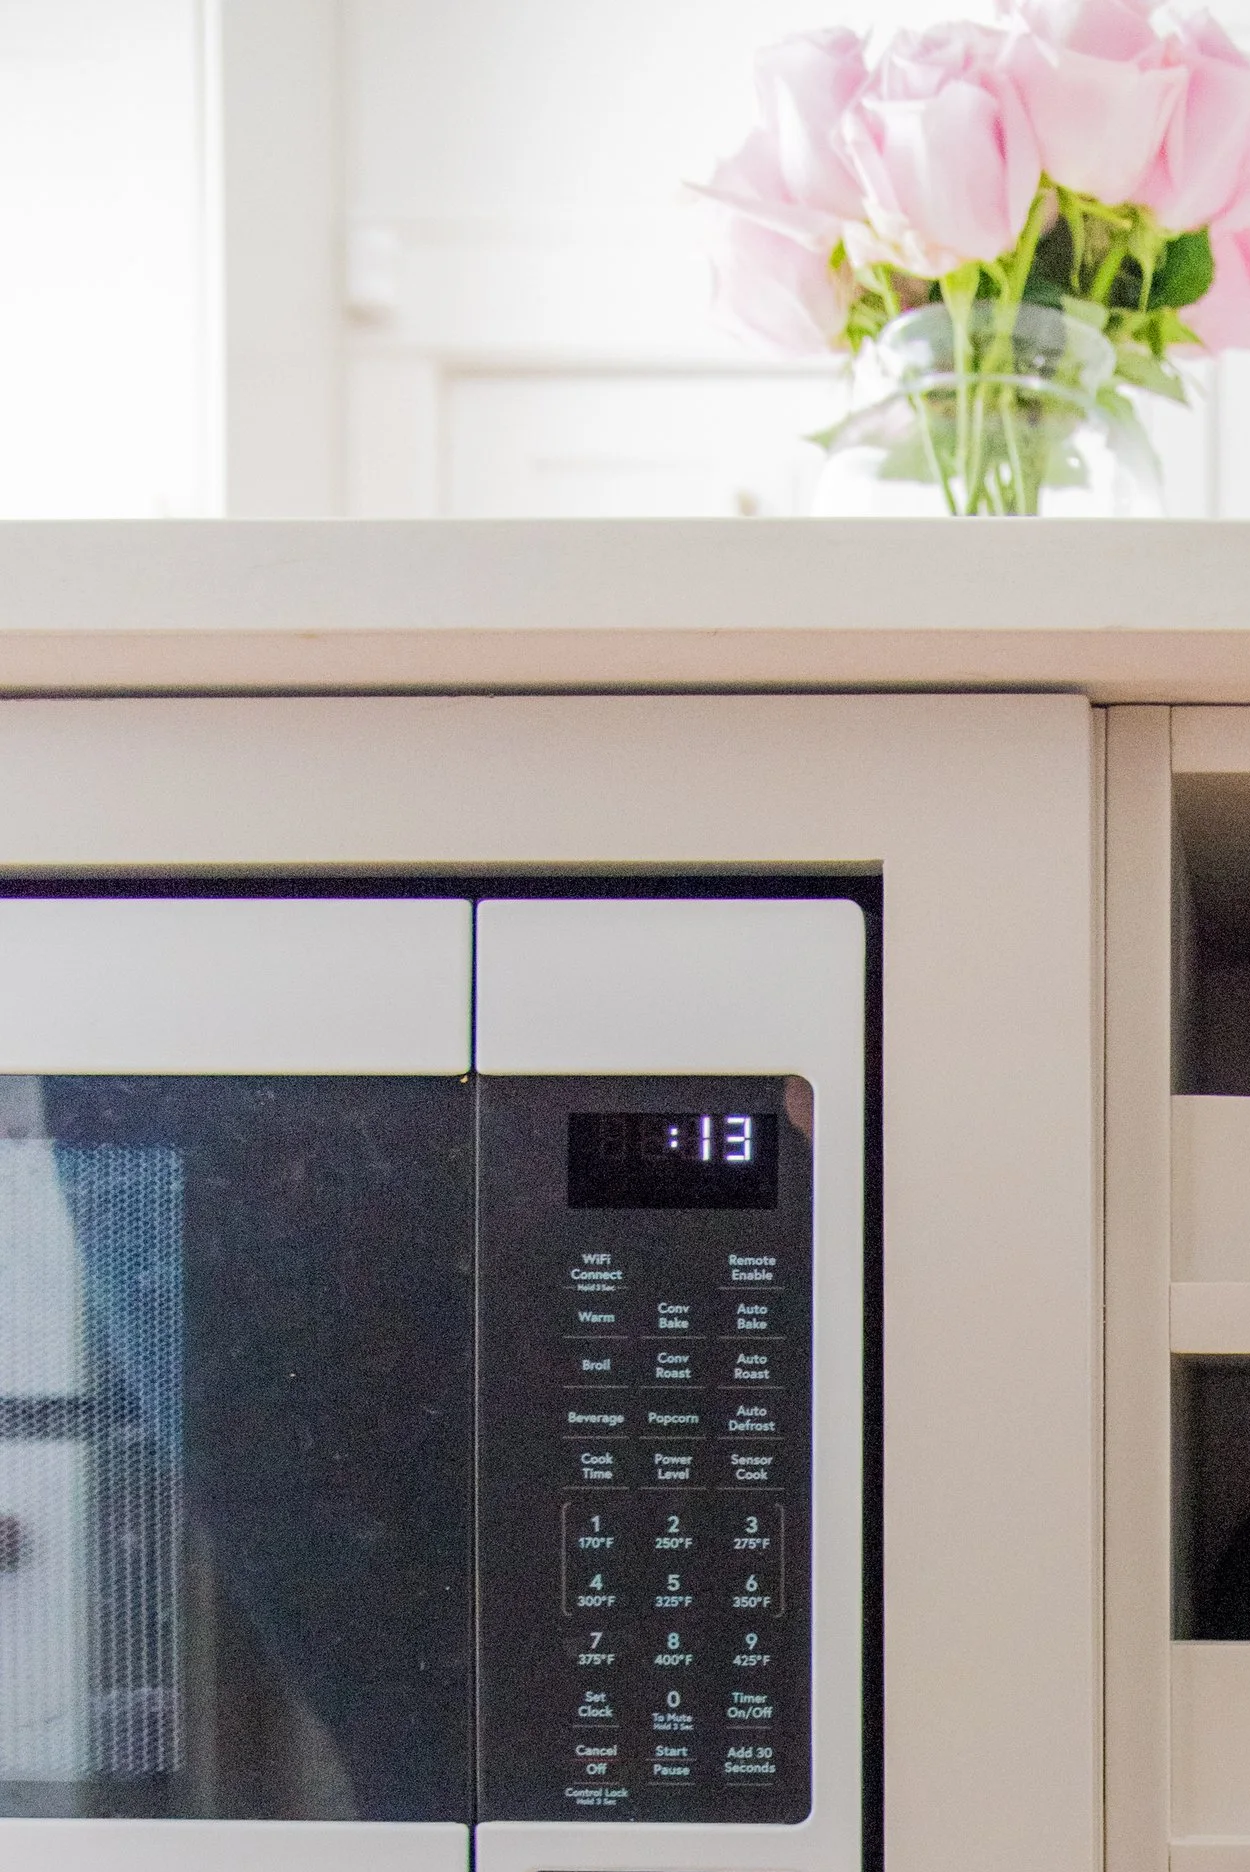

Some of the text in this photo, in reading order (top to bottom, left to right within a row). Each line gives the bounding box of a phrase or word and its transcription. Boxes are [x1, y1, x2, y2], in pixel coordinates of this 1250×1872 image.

[582, 1253, 611, 1264] WiFi
[729, 1255, 776, 1266] Remote
[571, 1269, 622, 1280] Connect
[732, 1269, 773, 1280] Enable
[658, 1302, 690, 1313] Conv
[737, 1303, 768, 1314] Auto
[579, 1311, 615, 1322] Warm
[659, 1318, 689, 1329] Bake
[738, 1318, 767, 1329] Bake
[658, 1352, 690, 1363] Conv
[737, 1354, 767, 1365] Auto
[582, 1359, 610, 1371] Broil
[656, 1368, 691, 1379] Roast
[734, 1368, 769, 1379] Roast
[737, 1405, 767, 1416] Auto
[568, 1413, 624, 1425] Beverage
[649, 1413, 699, 1425] Popcorn
[729, 1420, 775, 1431] Defrost
[581, 1454, 613, 1465] Cook
[655, 1454, 692, 1465] Power
[731, 1454, 773, 1465] Sensor
[582, 1468, 612, 1479] Time
[658, 1469, 689, 1480] Level
[736, 1469, 768, 1480] Cook
[591, 1516, 600, 1532] 1
[668, 1516, 680, 1533] 2
[746, 1517, 758, 1533] 3
[579, 1537, 614, 1548] 170°F
[656, 1537, 692, 1548] 250°F
[734, 1538, 770, 1549] 275°F
[590, 1574, 603, 1590] 4
[667, 1575, 680, 1591] 5
[746, 1575, 758, 1591] 6
[578, 1595, 616, 1606] 300°F
[656, 1596, 692, 1607] 325°F
[733, 1596, 771, 1607] 350°F
[590, 1632, 602, 1649] 7
[667, 1633, 680, 1649] 8
[746, 1633, 757, 1650] 9
[579, 1653, 615, 1664] 375°F
[655, 1654, 692, 1665] 400°F
[733, 1654, 770, 1665] 425°F
[585, 1691, 606, 1702] Set
[667, 1691, 680, 1707] 0
[732, 1692, 767, 1703] Timer
[579, 1706, 613, 1717] Clock
[728, 1707, 772, 1719] On/Off
[652, 1713, 692, 1722] To Mute
[576, 1745, 617, 1756] Cancel
[656, 1745, 688, 1756] Start
[728, 1747, 772, 1758] Add 30
[586, 1763, 607, 1774] Off
[654, 1764, 690, 1775] Pause
[725, 1762, 775, 1773] Seconds
[565, 1788, 628, 1797] Control Lock
